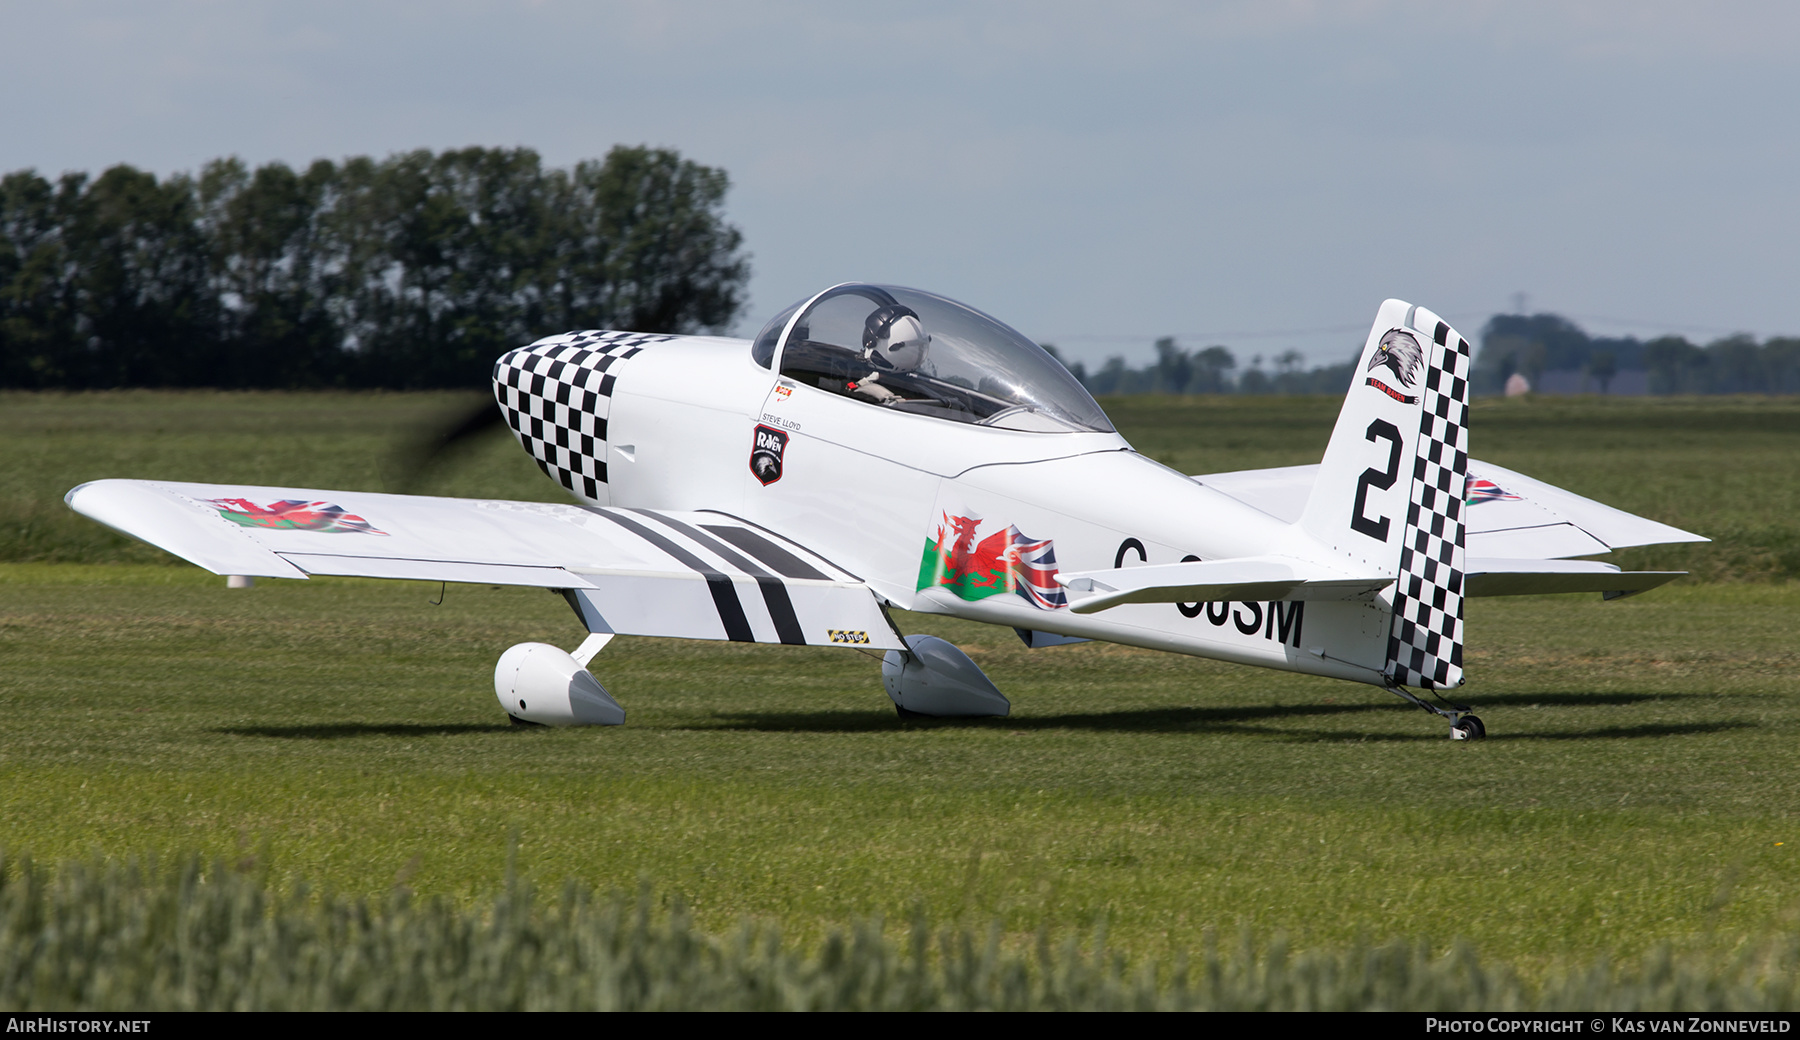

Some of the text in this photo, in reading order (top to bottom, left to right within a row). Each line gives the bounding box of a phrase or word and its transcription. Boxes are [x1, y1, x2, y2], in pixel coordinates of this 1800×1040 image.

[1371, 379, 1405, 403] TEAM RAVEN
[762, 413, 802, 431] STEVE LLOYD
[1350, 418, 1404, 543] 2
[845, 633, 865, 641] STEP
